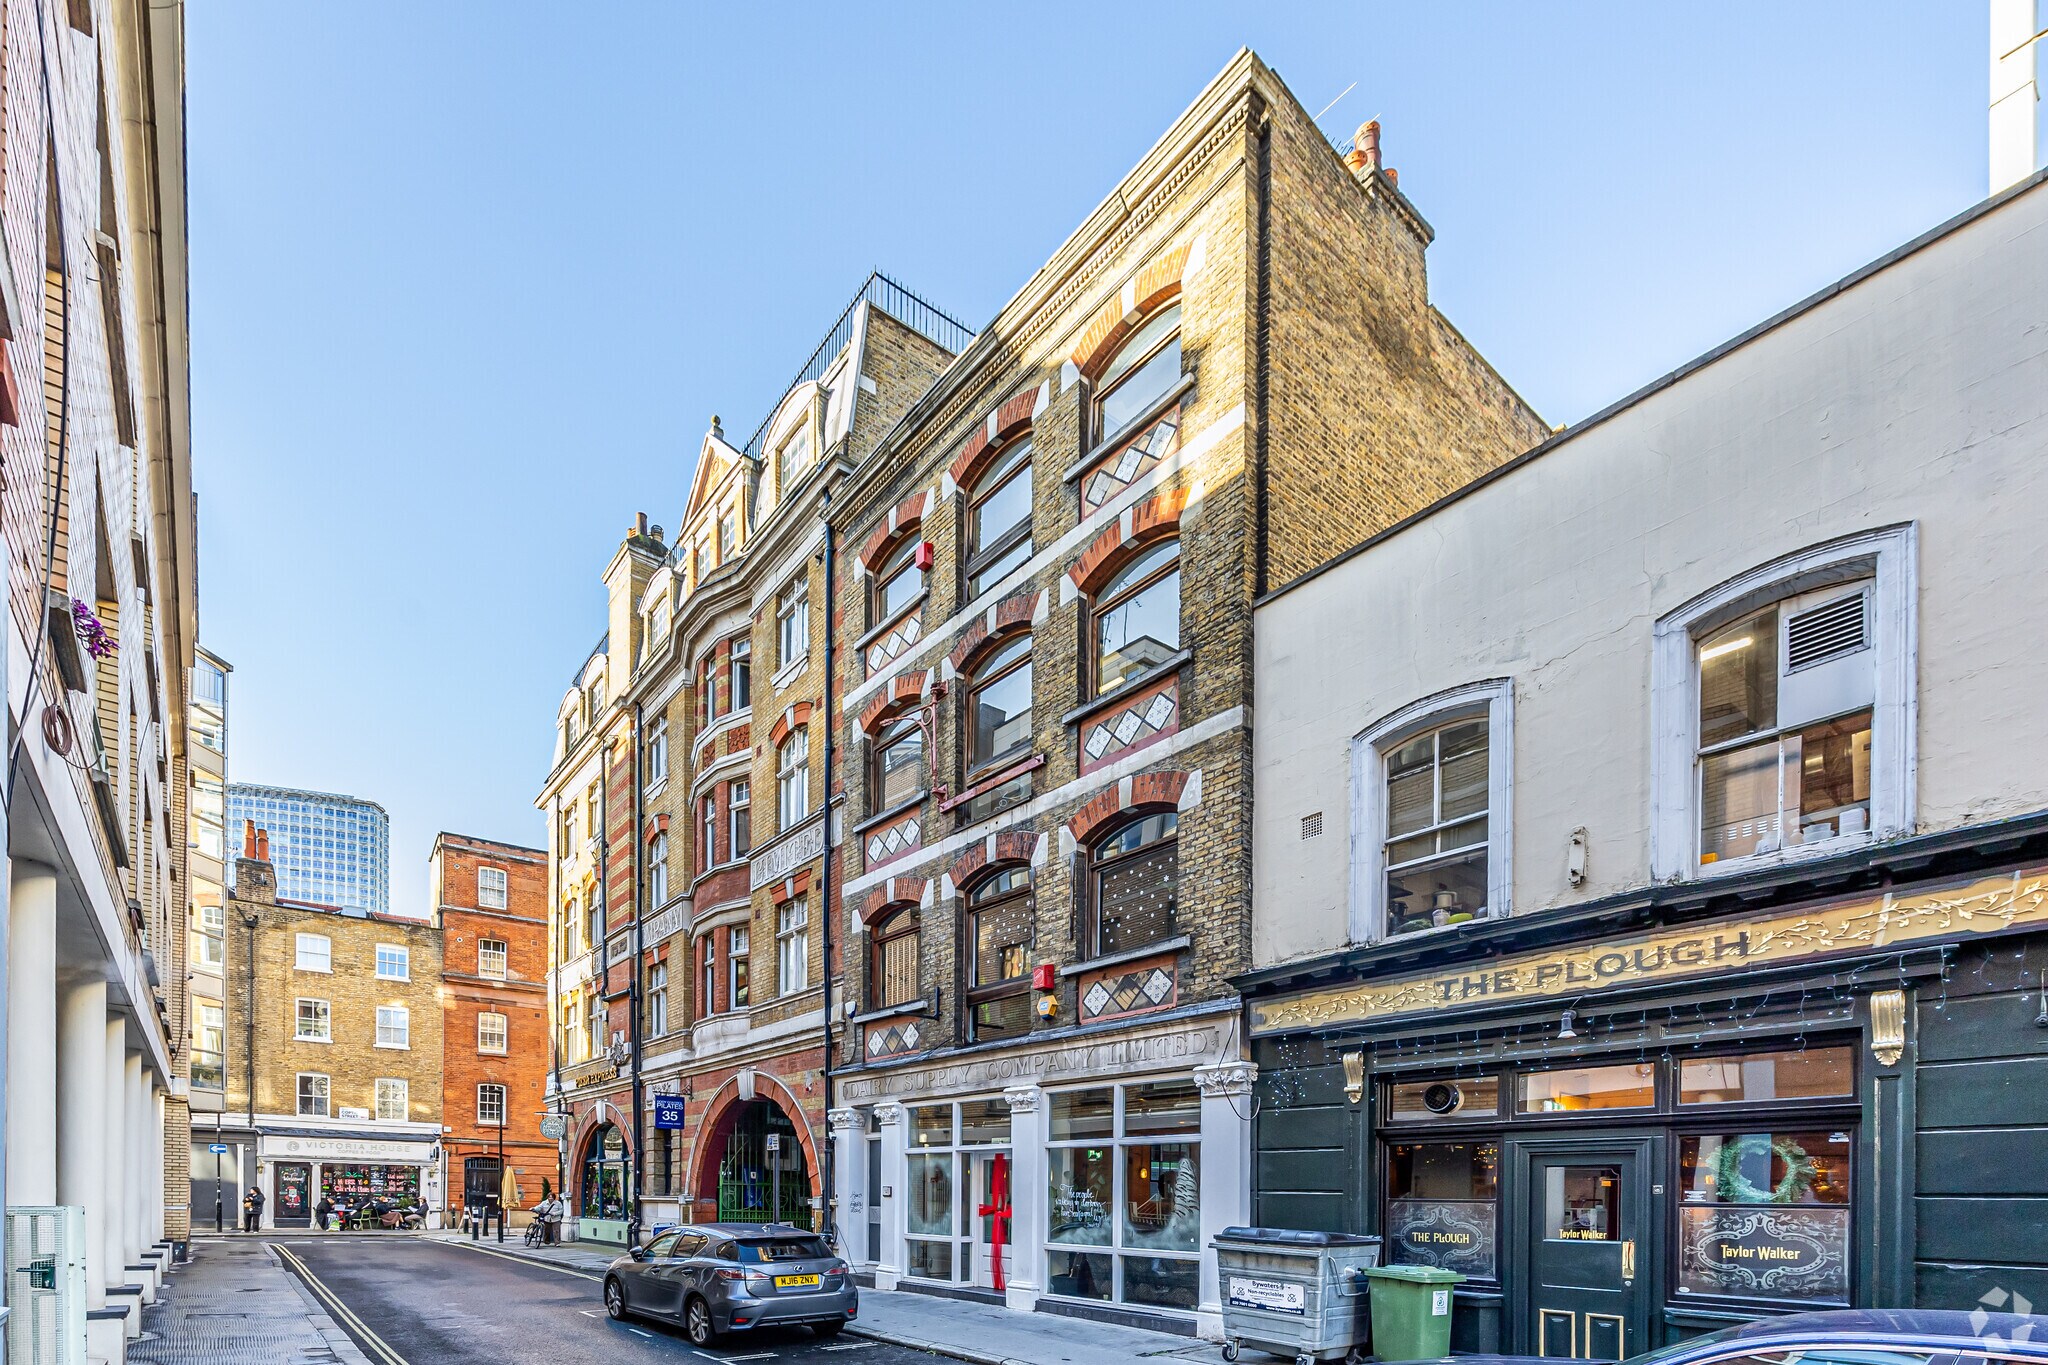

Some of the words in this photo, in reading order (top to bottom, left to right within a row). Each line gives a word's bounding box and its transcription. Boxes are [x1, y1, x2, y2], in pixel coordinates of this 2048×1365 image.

[1436, 967, 1519, 1001] THE
[1536, 931, 1751, 986] PLOUGH
[849, 1078, 892, 1099] DAIRY
[904, 1066, 971, 1092] SUPPLY
[986, 1046, 1095, 1081] COMPANY
[1108, 1032, 1208, 1066] LIMITED
[591, 1065, 617, 1084] EXPRESS
[656, 1102, 684, 1110] PILATES
[662, 1110, 678, 1121] 35
[306, 1141, 365, 1150] VICTORIA
[371, 1144, 411, 1152] HOUSE
[1059, 1184, 1076, 1198] The
[1076, 1188, 1095, 1200] people
[1411, 1231, 1430, 1242] THE
[1433, 1232, 1470, 1244] PLOUGH
[1559, 1229, 1580, 1239] Taylor
[1581, 1229, 1607, 1240] Walker
[1720, 1244, 1756, 1259] Taylor
[1757, 1245, 1801, 1260] Walker
[781, 1276, 798, 1285] MJ16
[800, 1275, 815, 1284] ZNX
[1252, 1280, 1280, 1290] Bywaters
[1247, 1288, 1285, 1298] Non-recyclables
